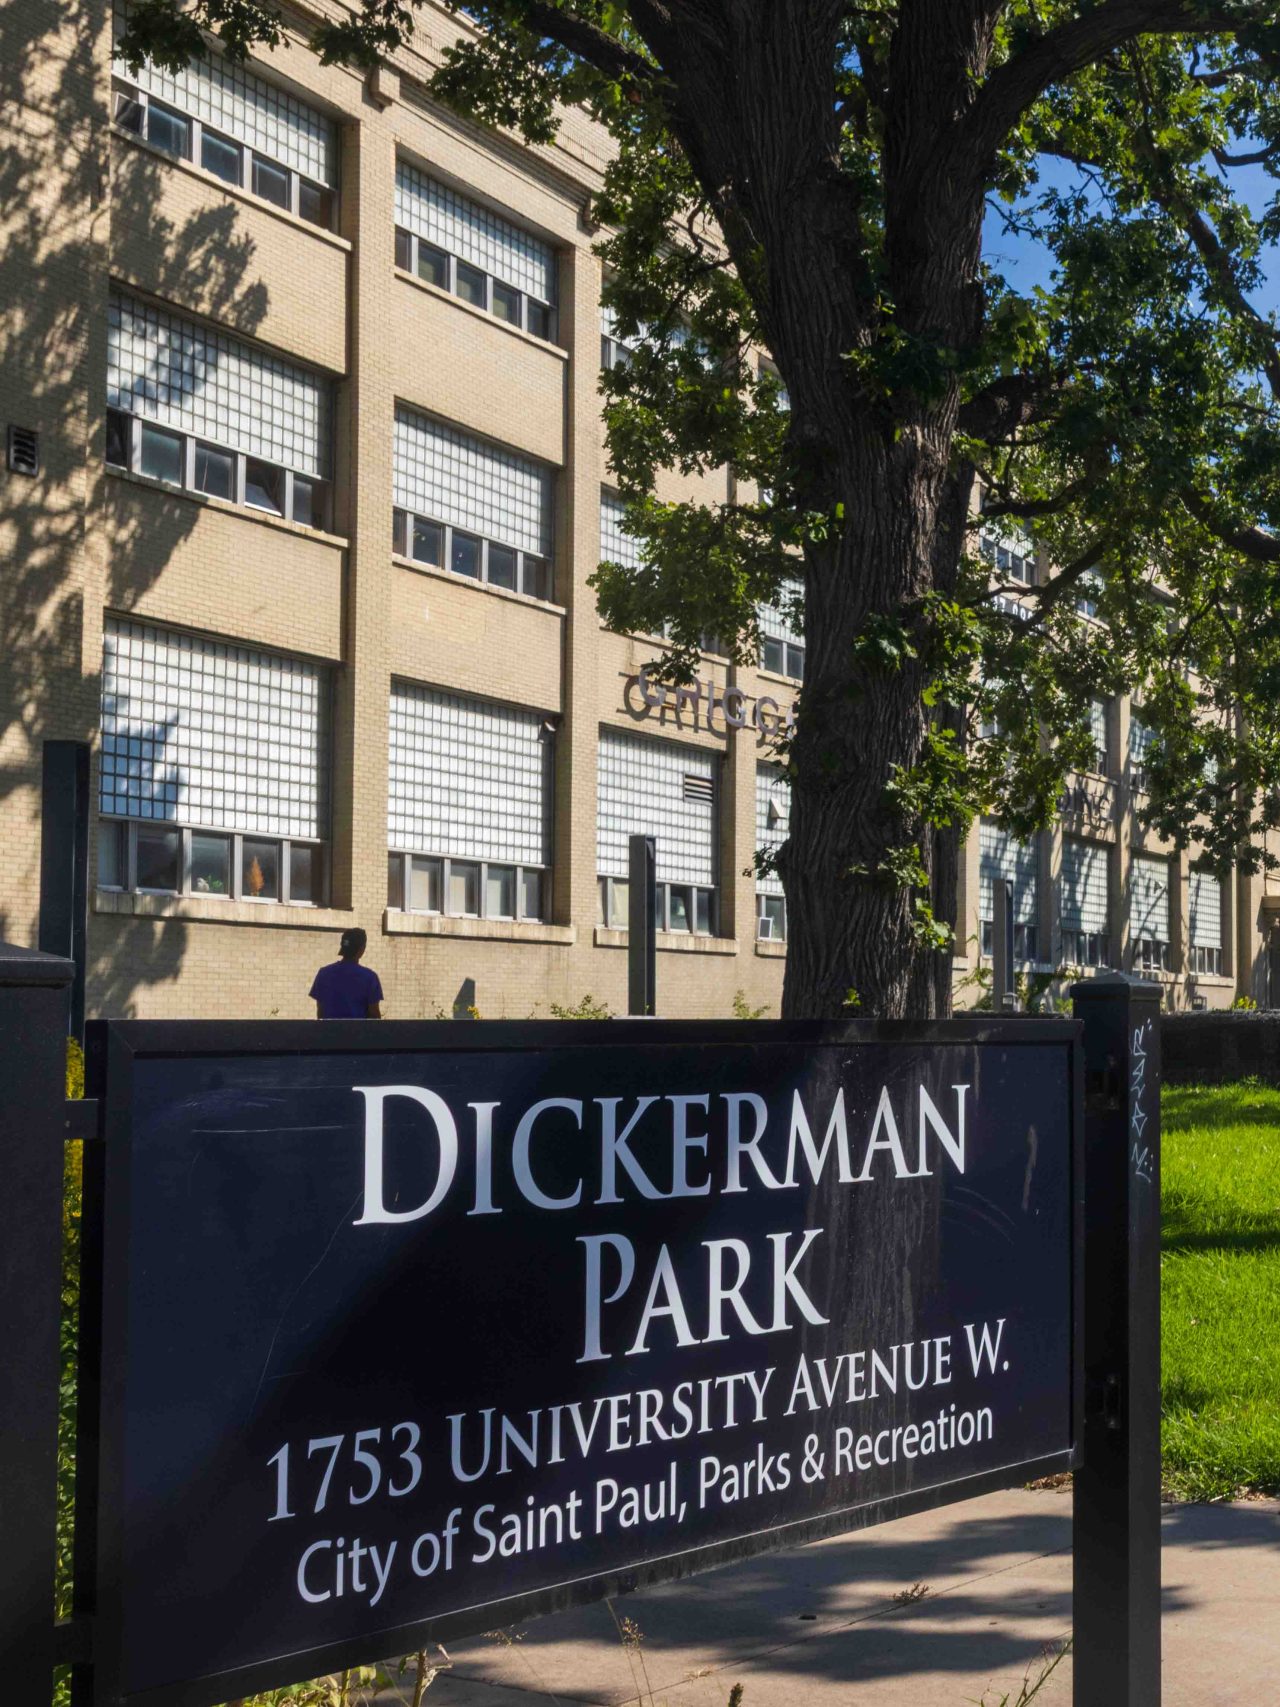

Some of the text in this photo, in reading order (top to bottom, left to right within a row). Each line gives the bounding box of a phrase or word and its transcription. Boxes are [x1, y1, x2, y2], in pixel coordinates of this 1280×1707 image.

[350, 1083, 972, 1226] DICKERMAN
[574, 1227, 832, 1364] PARK
[265, 1318, 1010, 1523] 1753 UNIVERSITY AVENUE W.
[296, 1406, 993, 1607] City of Saint Paul, Parks & Recreation
